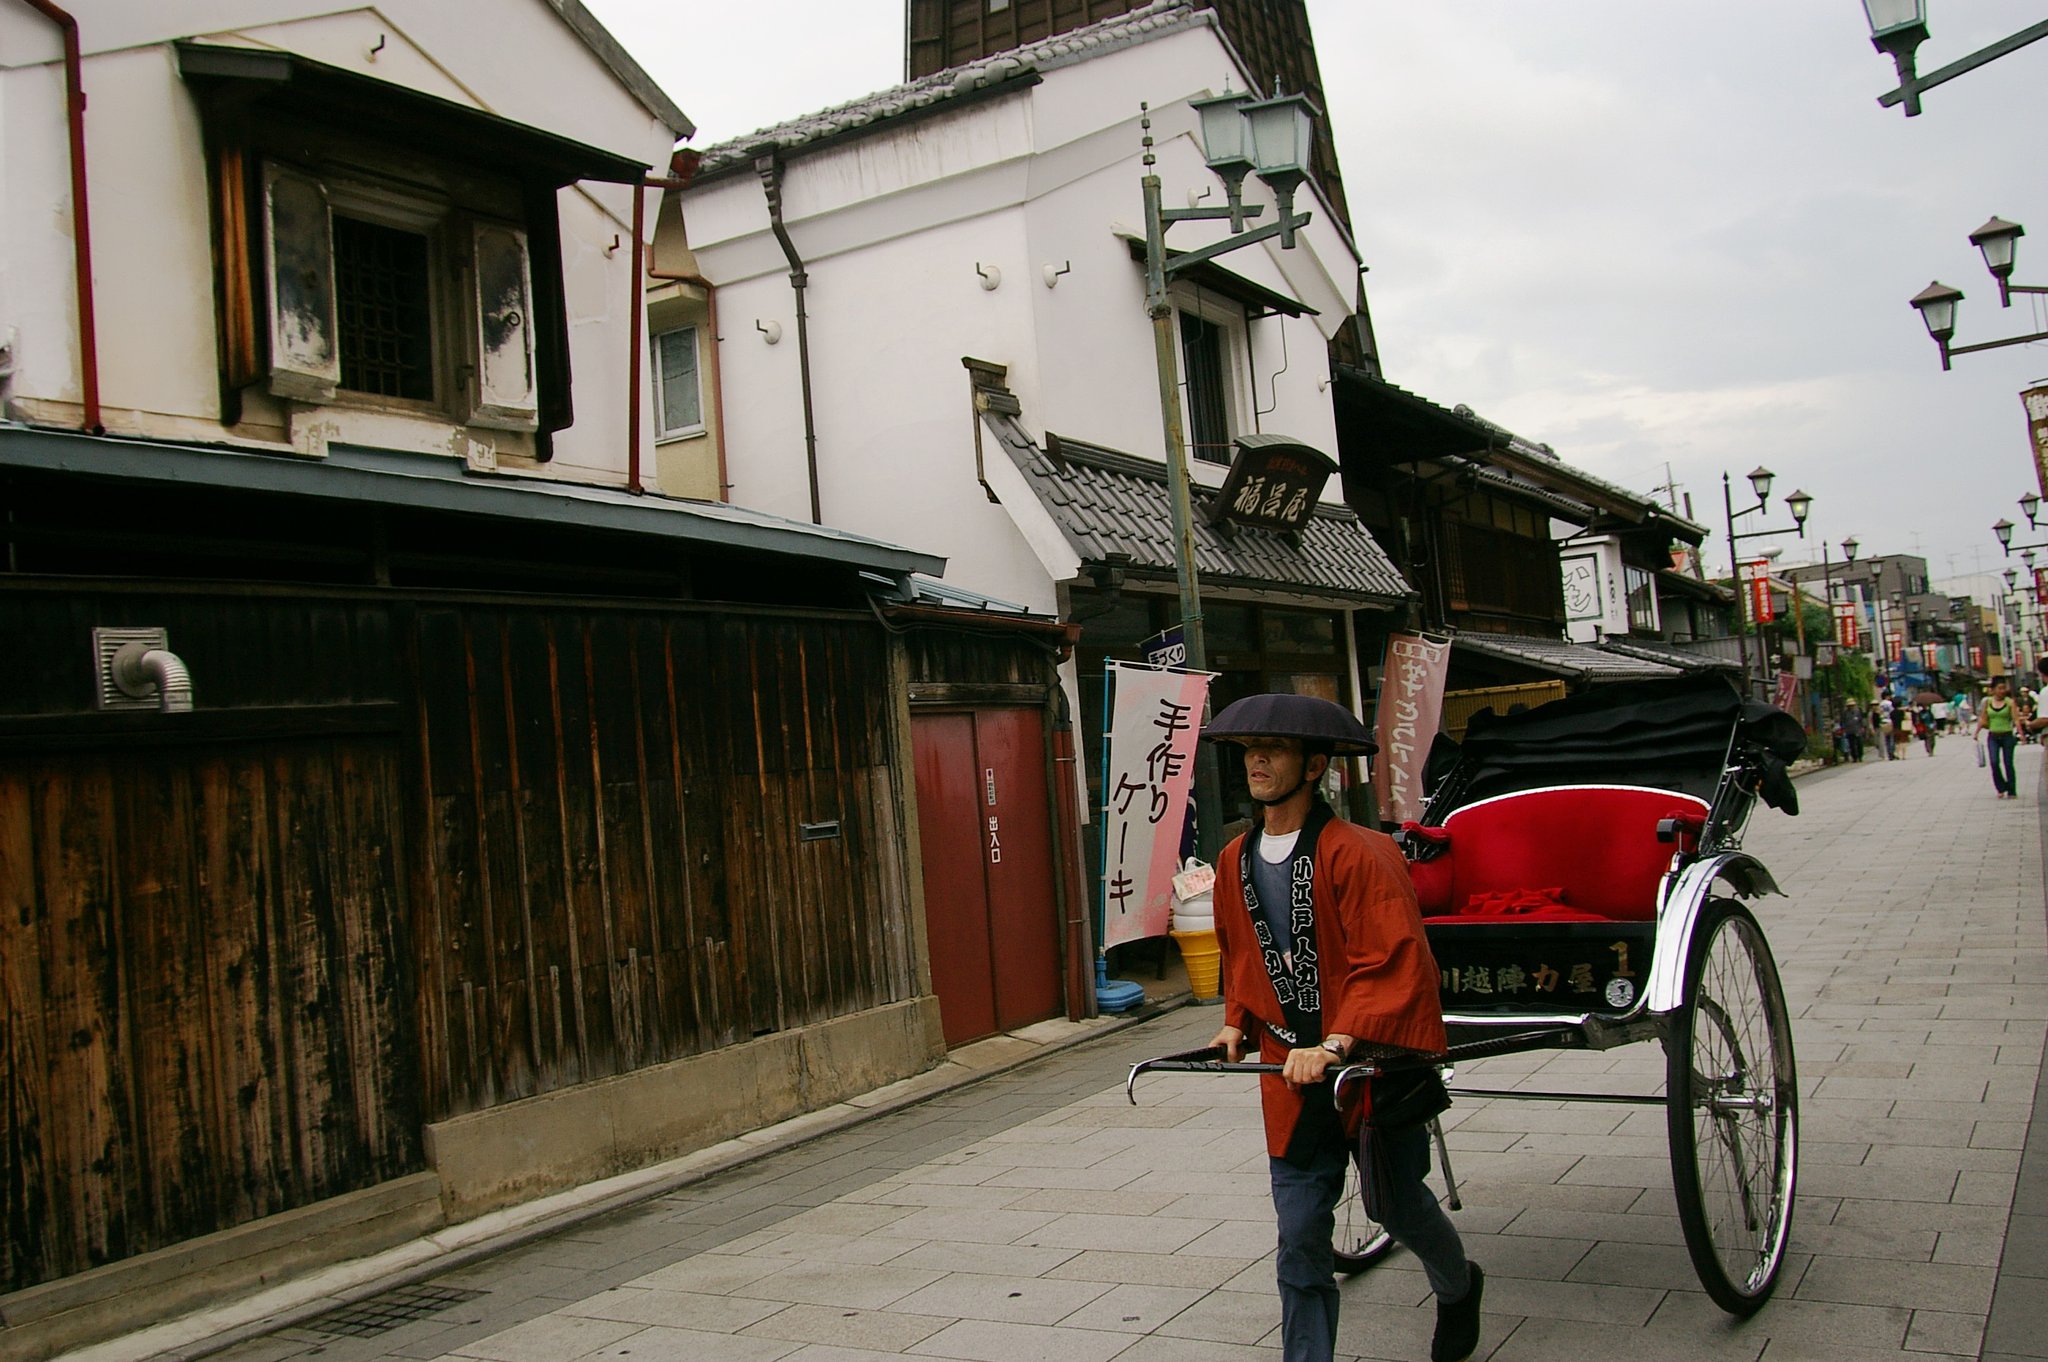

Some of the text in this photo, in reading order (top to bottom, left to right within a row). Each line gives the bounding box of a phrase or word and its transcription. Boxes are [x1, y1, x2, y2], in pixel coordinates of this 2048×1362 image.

[1146, 698, 1192, 825] 手作り
[988, 815, 1002, 864] 出入口
[1109, 771, 1147, 914] ケーキ
[1291, 855, 1321, 1013] 小江戸人力車
[1608, 940, 1637, 977] 1
